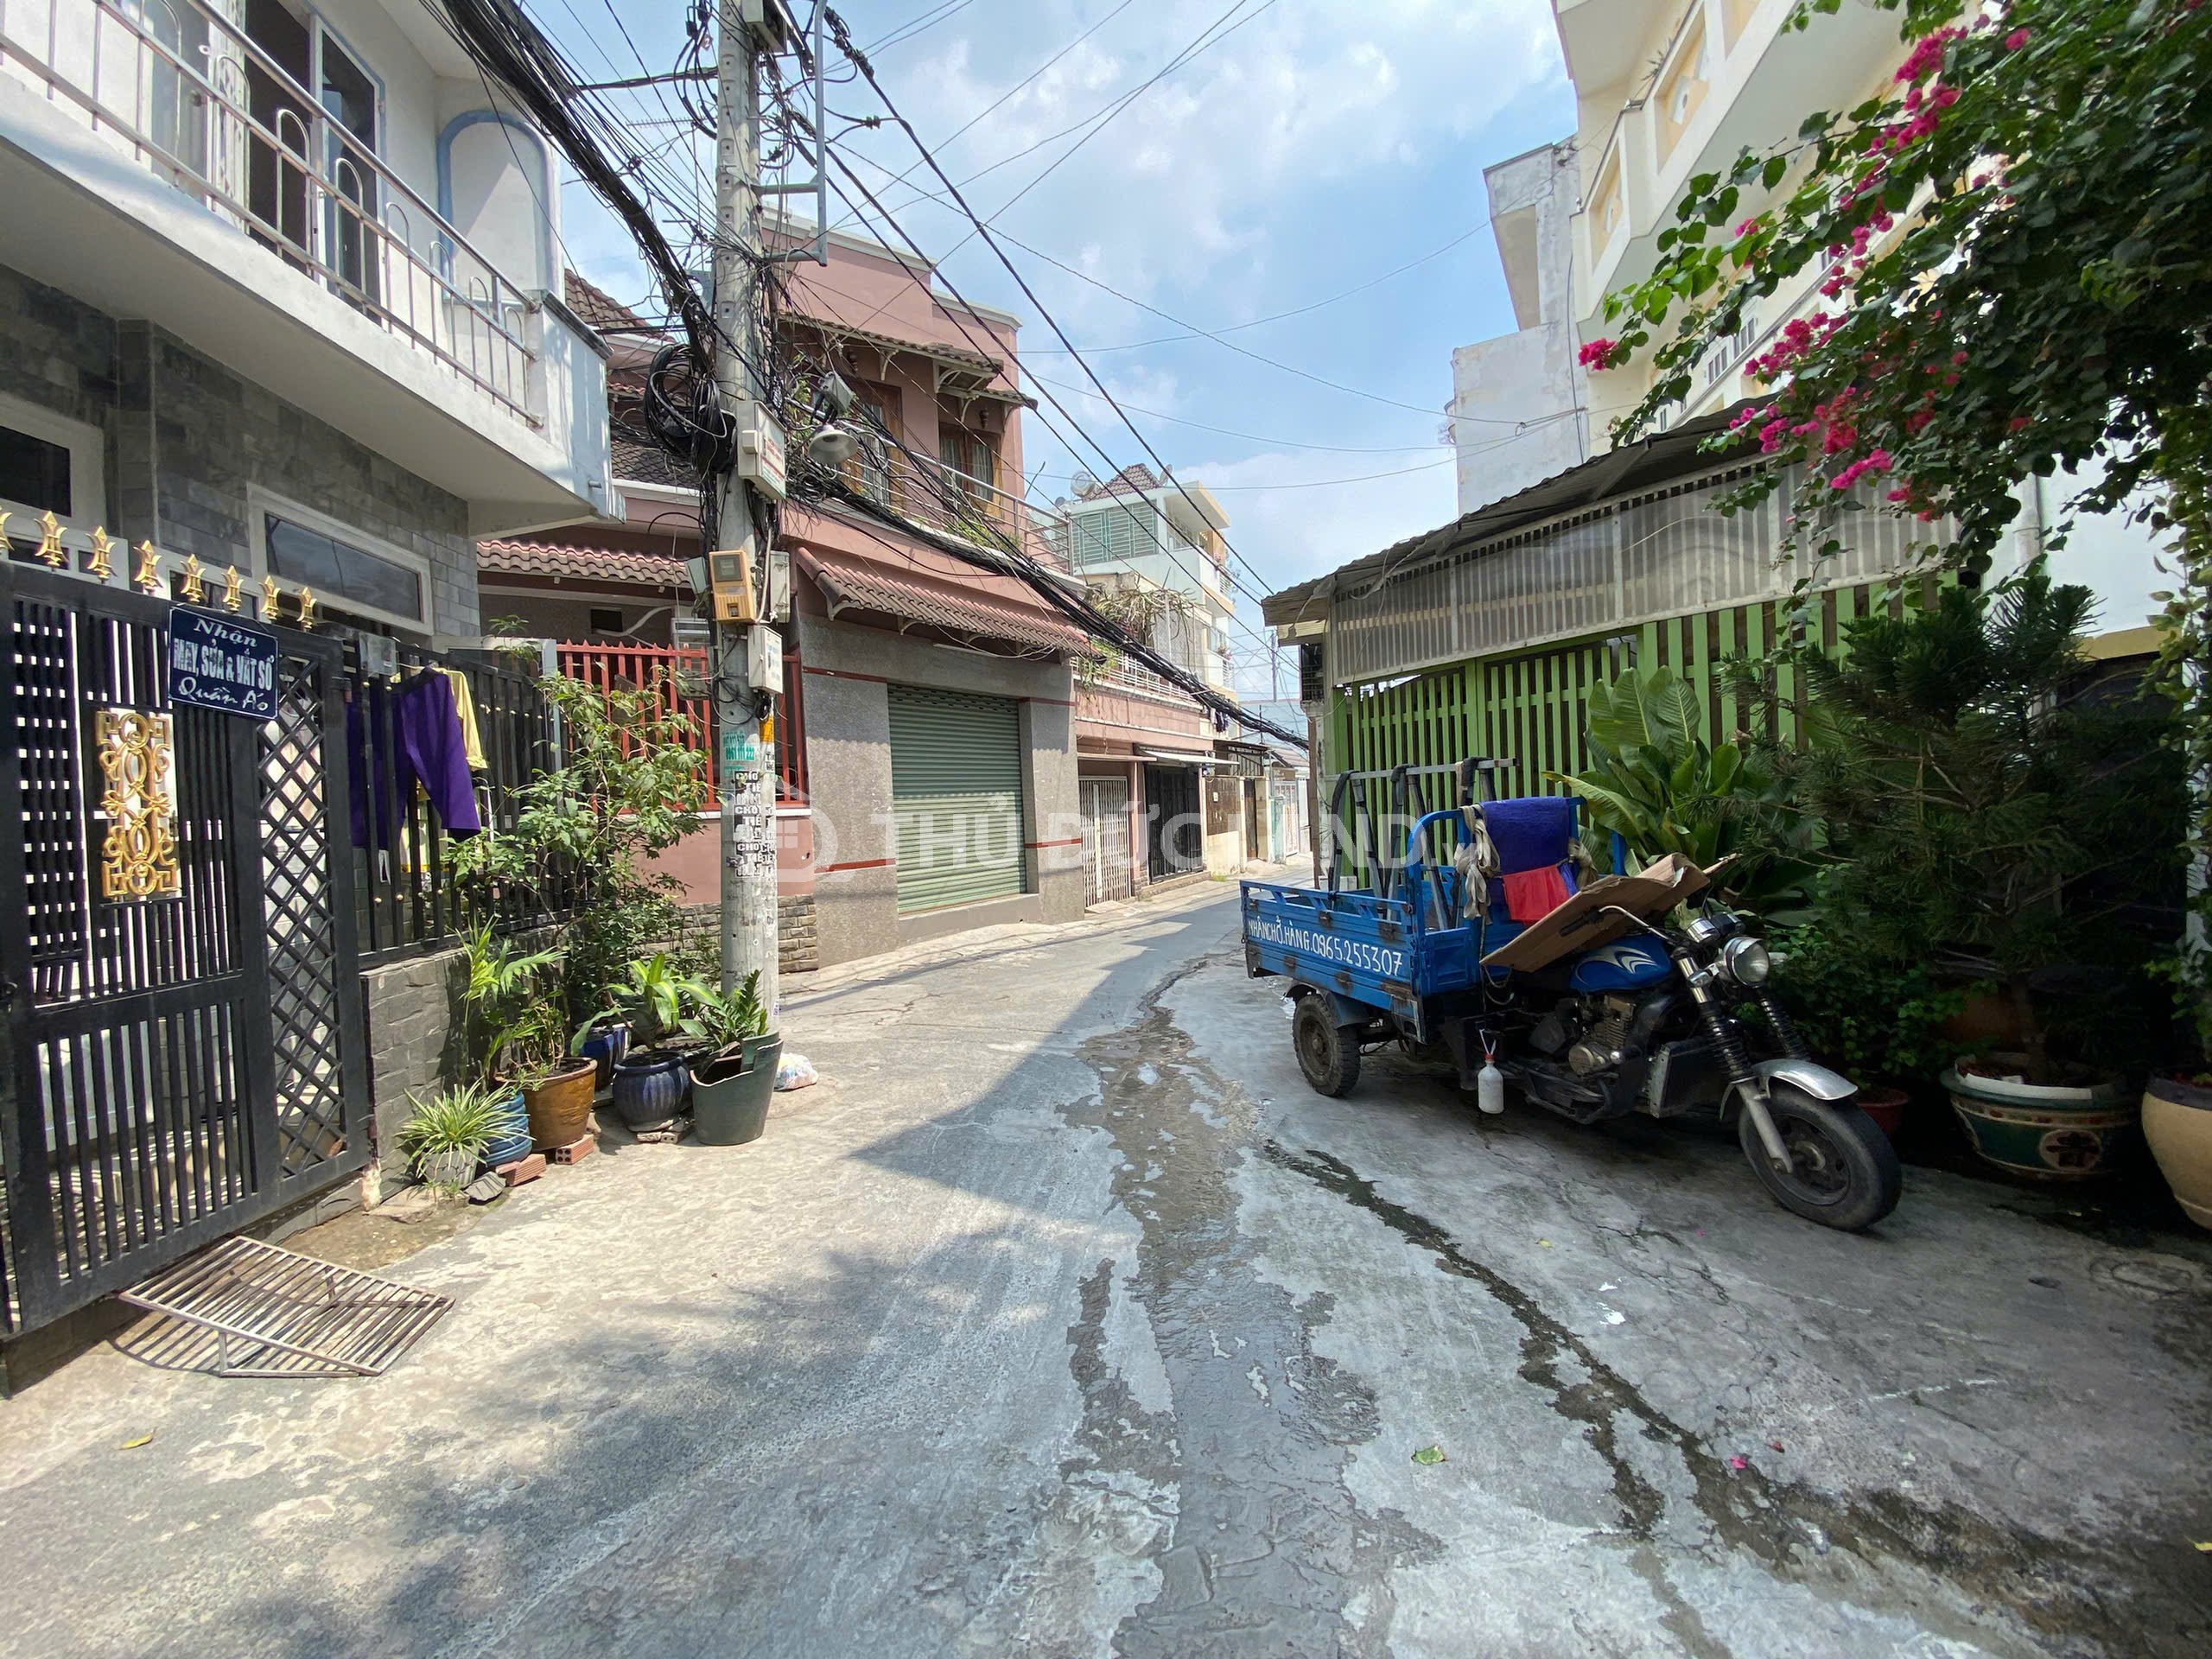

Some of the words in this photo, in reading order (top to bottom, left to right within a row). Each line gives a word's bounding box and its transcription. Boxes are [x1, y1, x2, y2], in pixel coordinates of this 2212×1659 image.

[194, 618, 257, 647] Nhận
[201, 638, 225, 680] SỬA
[226, 656, 235, 682] &
[257, 654, 275, 691] SỔ
[178, 677, 238, 703] Quần
[243, 690, 269, 711] Áo
